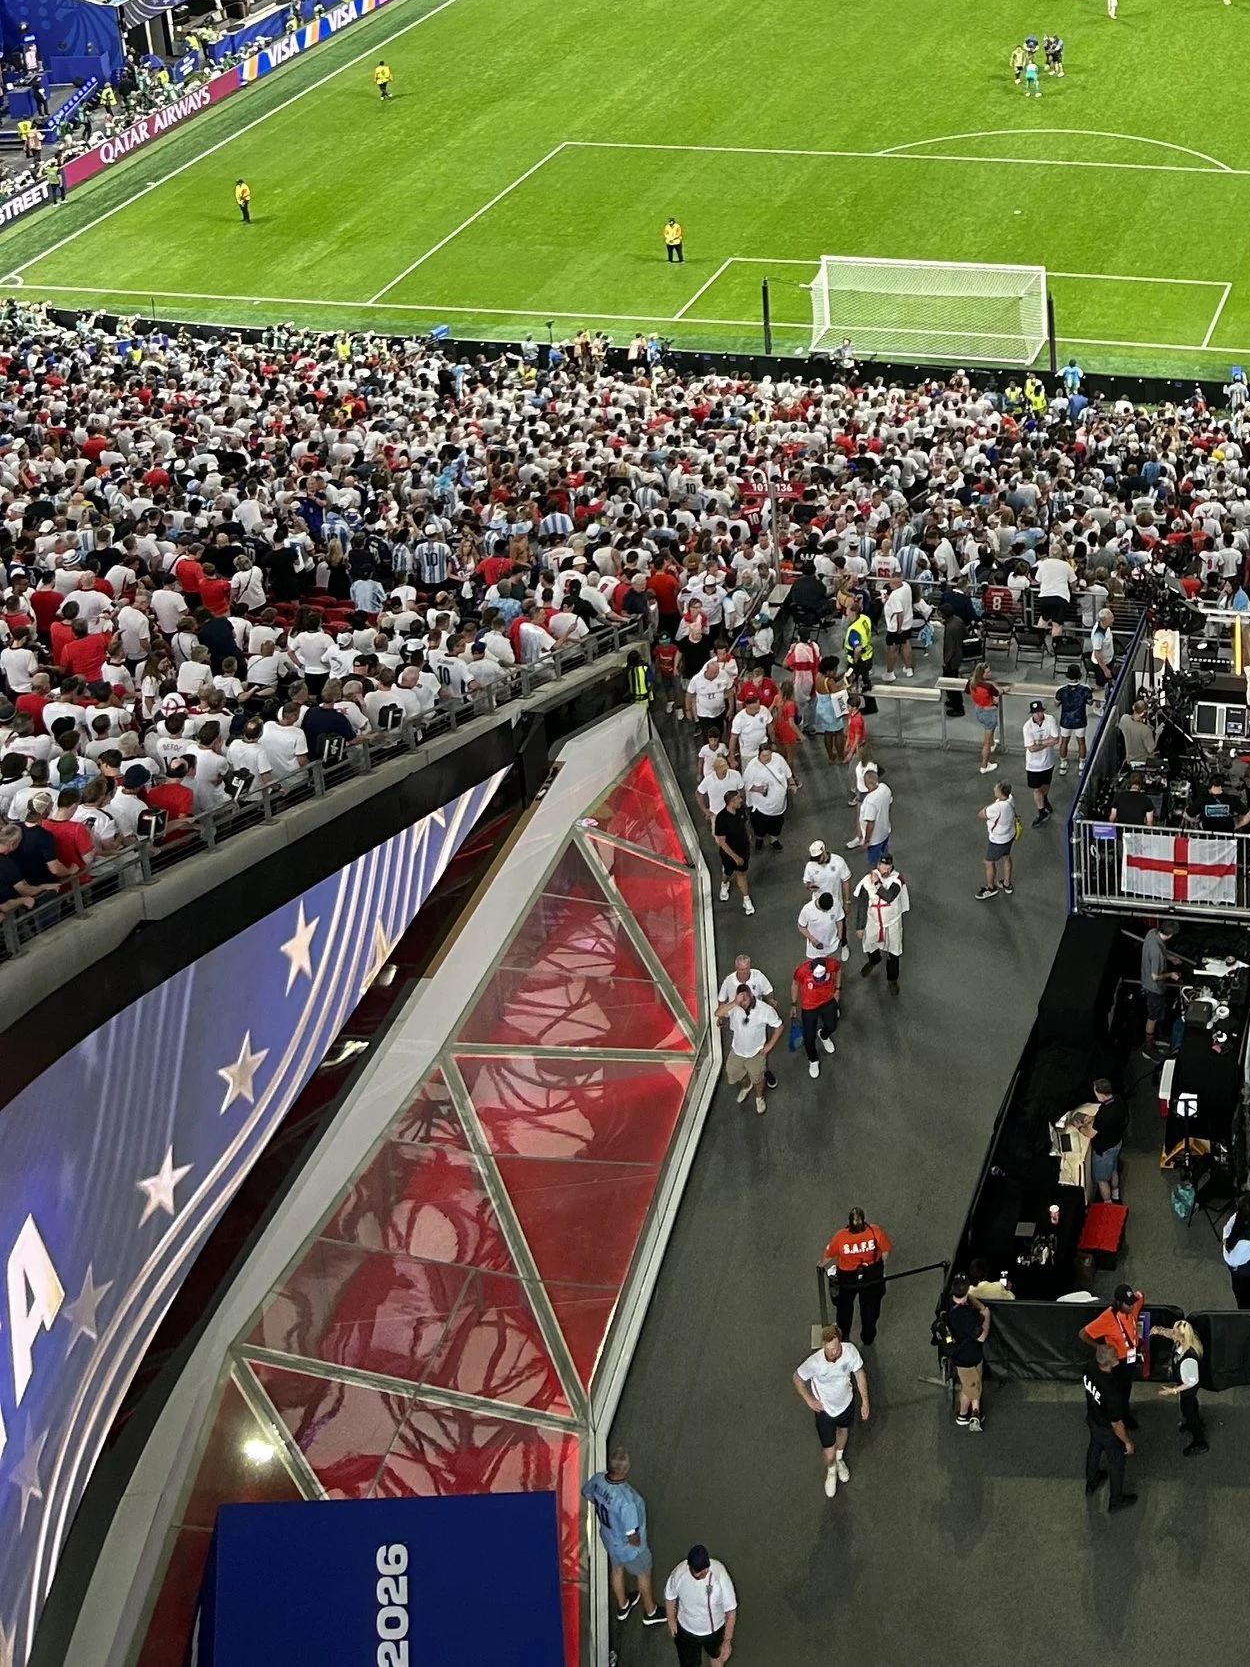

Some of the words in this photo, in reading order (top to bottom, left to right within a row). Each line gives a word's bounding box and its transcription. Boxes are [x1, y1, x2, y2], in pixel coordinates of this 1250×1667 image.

[327, 1, 358, 32] VISA
[268, 33, 301, 68] VISA
[99, 123, 151, 164] QATAR
[153, 85, 211, 135] AIRWAYS
[751, 482, 769, 493] 101
[775, 482, 793, 493] 136
[424, 552, 438, 567] 10
[993, 596, 1002, 611] 8
[437, 665, 451, 686] 10
[376, 1541, 410, 1667] 2026
